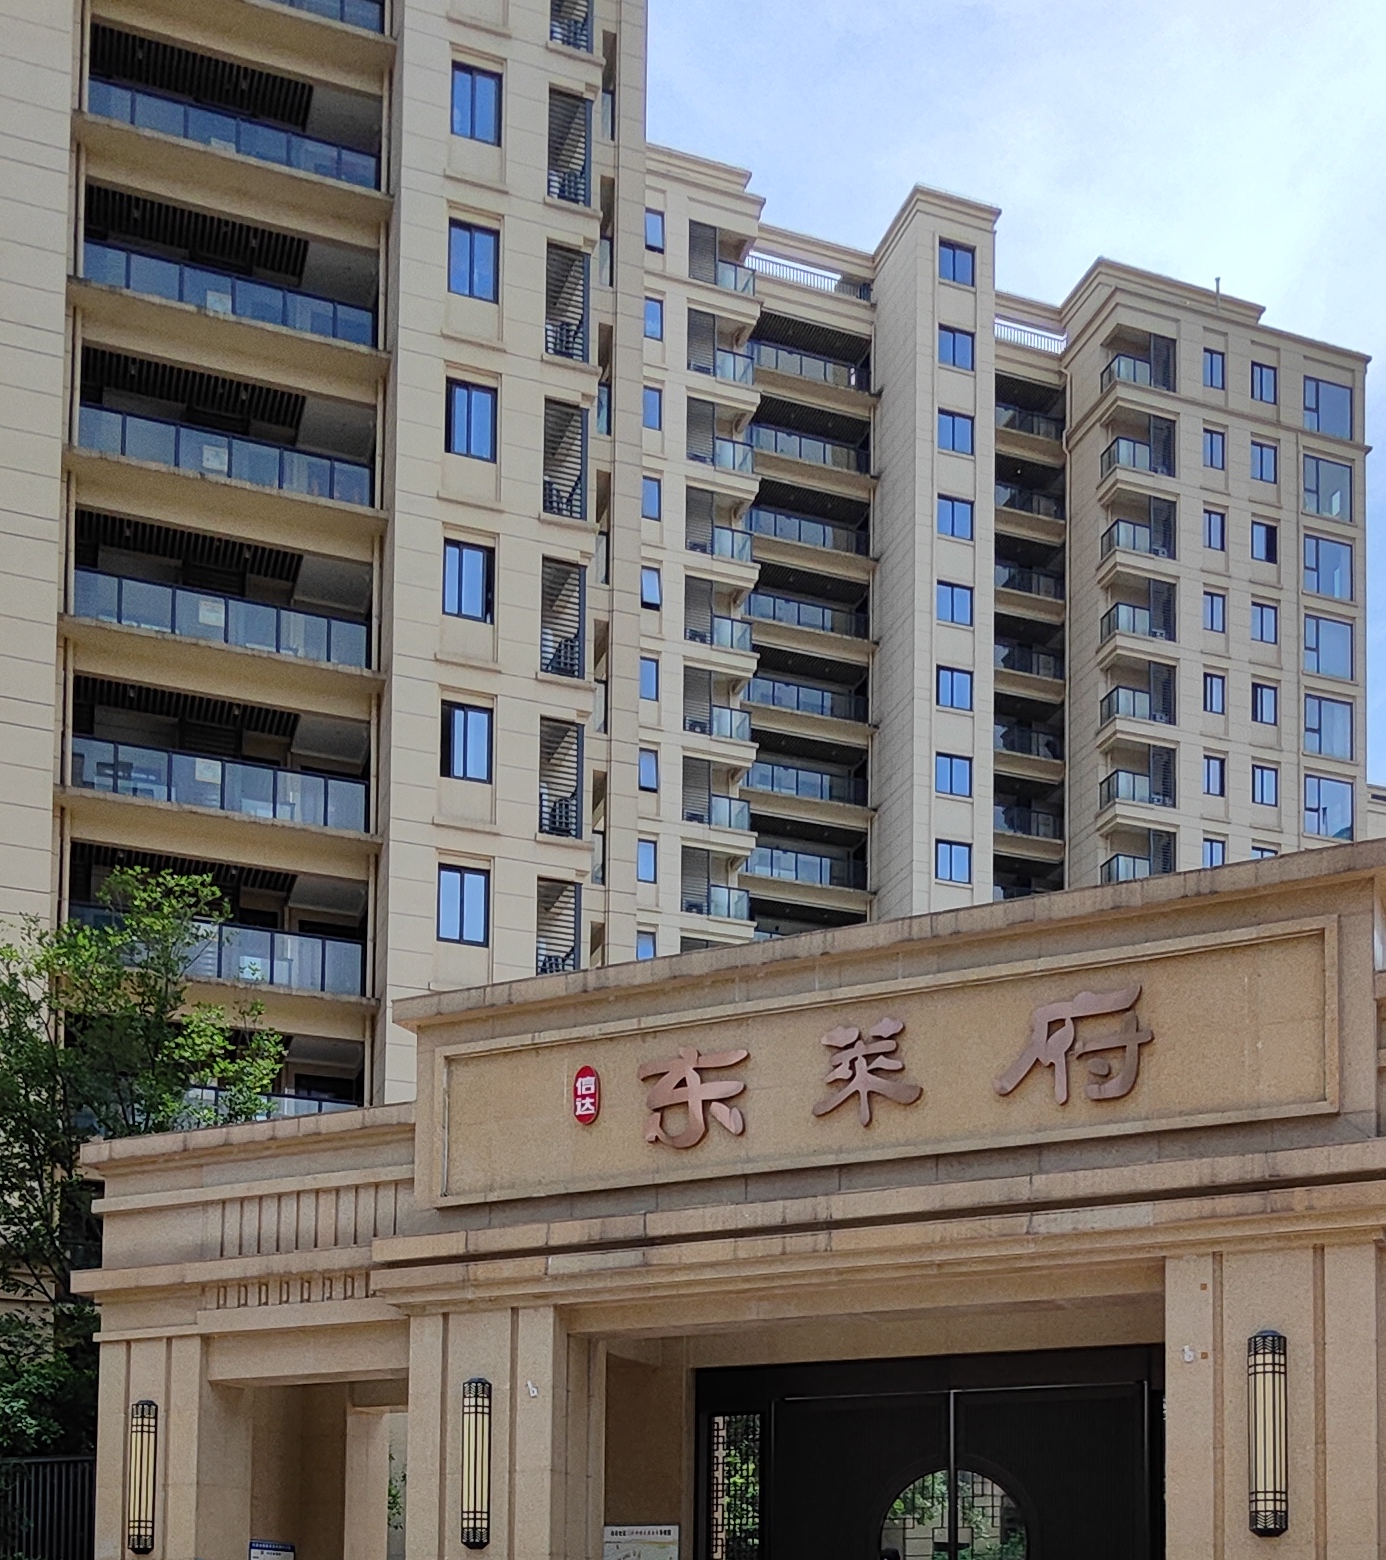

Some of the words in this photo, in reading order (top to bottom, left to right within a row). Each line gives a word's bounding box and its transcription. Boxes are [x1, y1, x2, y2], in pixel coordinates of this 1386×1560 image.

[575, 1076, 596, 1116] 信达
[637, 984, 1154, 1149] 东莱府
